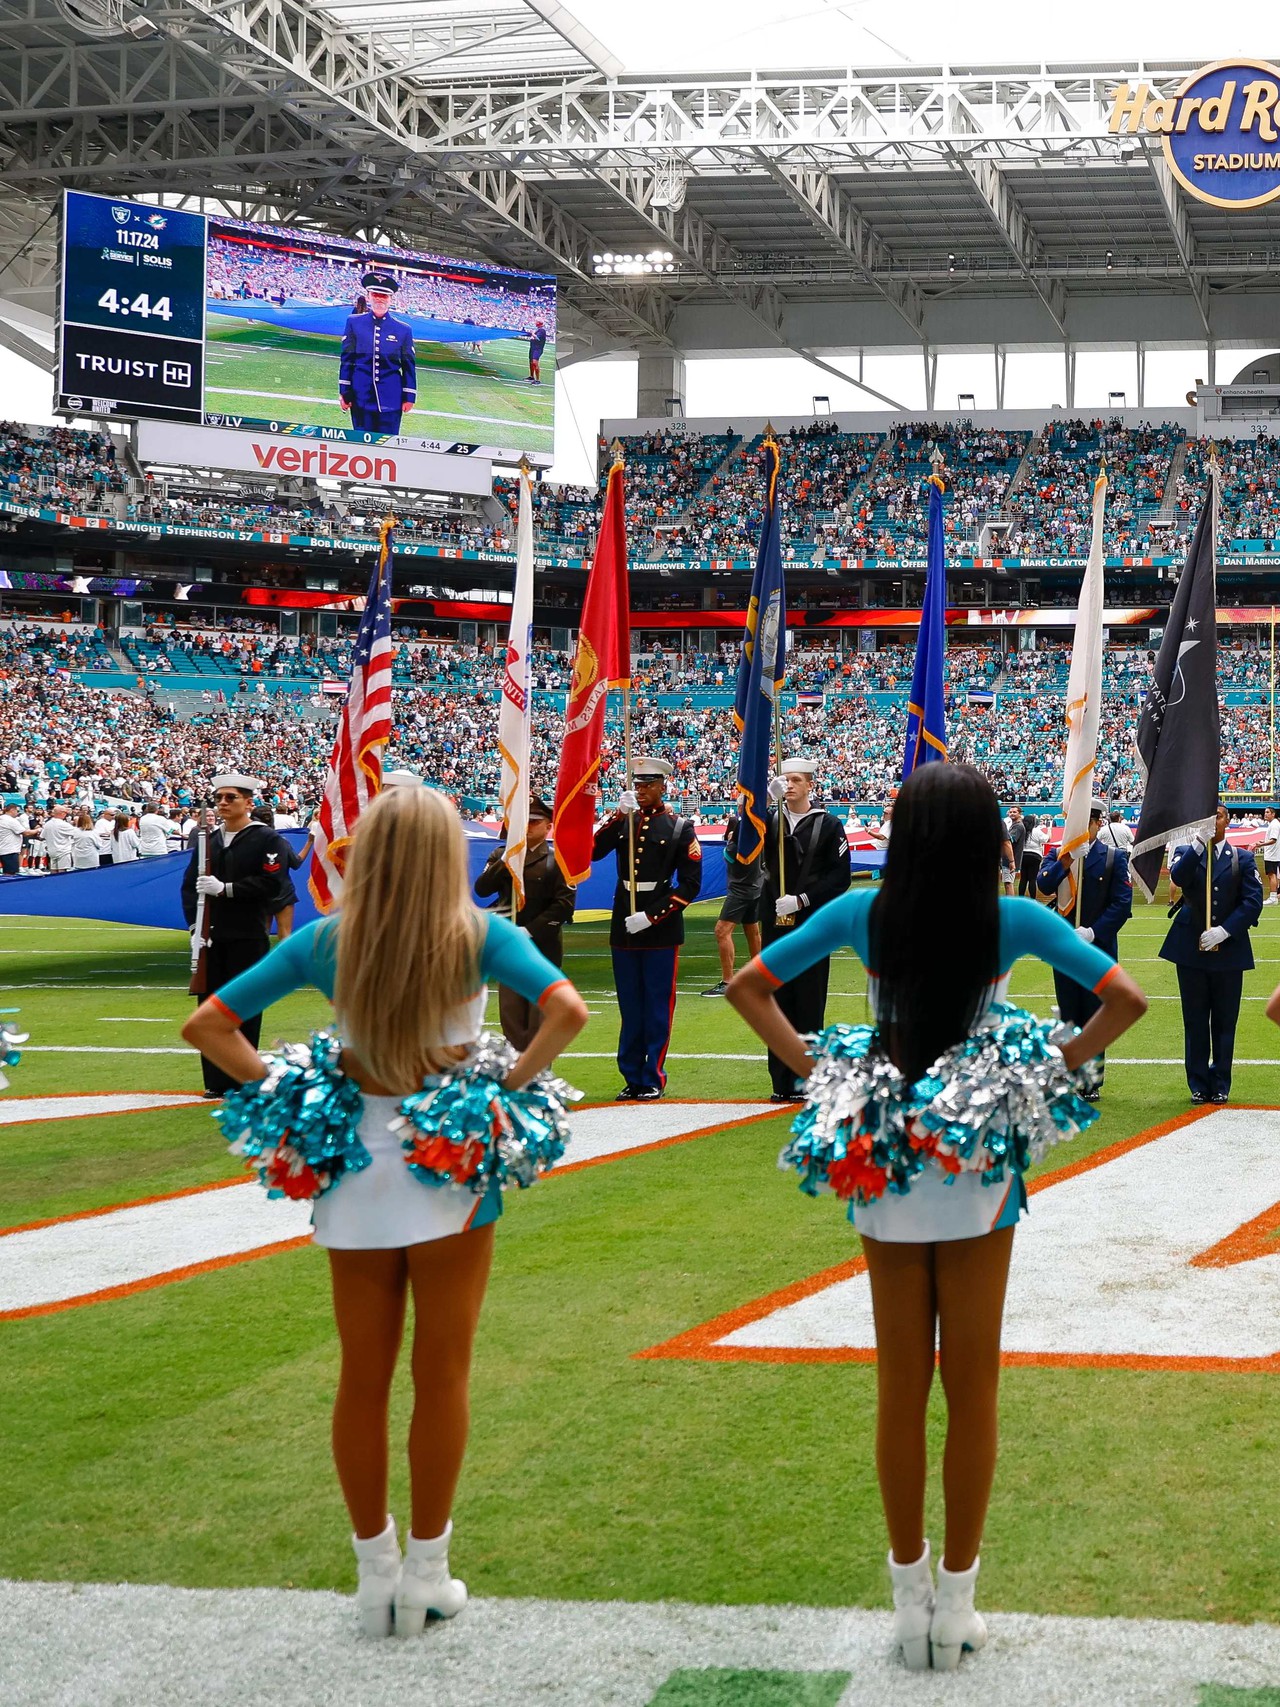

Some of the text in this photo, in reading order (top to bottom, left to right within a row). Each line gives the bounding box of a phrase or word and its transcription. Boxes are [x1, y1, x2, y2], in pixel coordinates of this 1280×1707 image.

[1108, 80, 1237, 134] Hard
[116, 229, 159, 250] 11.17.24
[143, 254, 172, 267] SOLIS
[98, 288, 173, 321] 4:44
[75, 353, 159, 379] TRUIST
[92, 399, 117, 409] WELCOME
[92, 405, 111, 414] UNITED
[671, 422, 687, 431] 328
[1250, 424, 1268, 433] 332
[225, 416, 243, 428] LV
[270, 422, 278, 432] 0
[321, 428, 347, 440] MIA
[363, 432, 372, 443] 0
[420, 441, 441, 450] 4:44
[457, 445, 469, 454] 25
[251, 443, 397, 482] verizon
[5, 502, 28, 516] LITTLE
[29, 508, 40, 518] 66
[116, 521, 253, 541] DWIGHT STEPHENSON 57
[310, 538, 419, 555] BOB KUECHENBG 67
[478, 552, 518, 564] RICHMON
[557, 559, 569, 568] 78
[633, 561, 686, 570] BAUMHOWER
[689, 561, 701, 570] 73
[812, 560, 824, 569] 75
[875, 559, 899, 569] JOHN
[949, 559, 961, 568] 56
[1020, 559, 1048, 567] MARK
[1050, 558, 1088, 567] CLAYTON
[1223, 557, 1243, 565] DAN
[1245, 557, 1280, 565] MARINO
[1150, 681, 1167, 713] TATE
